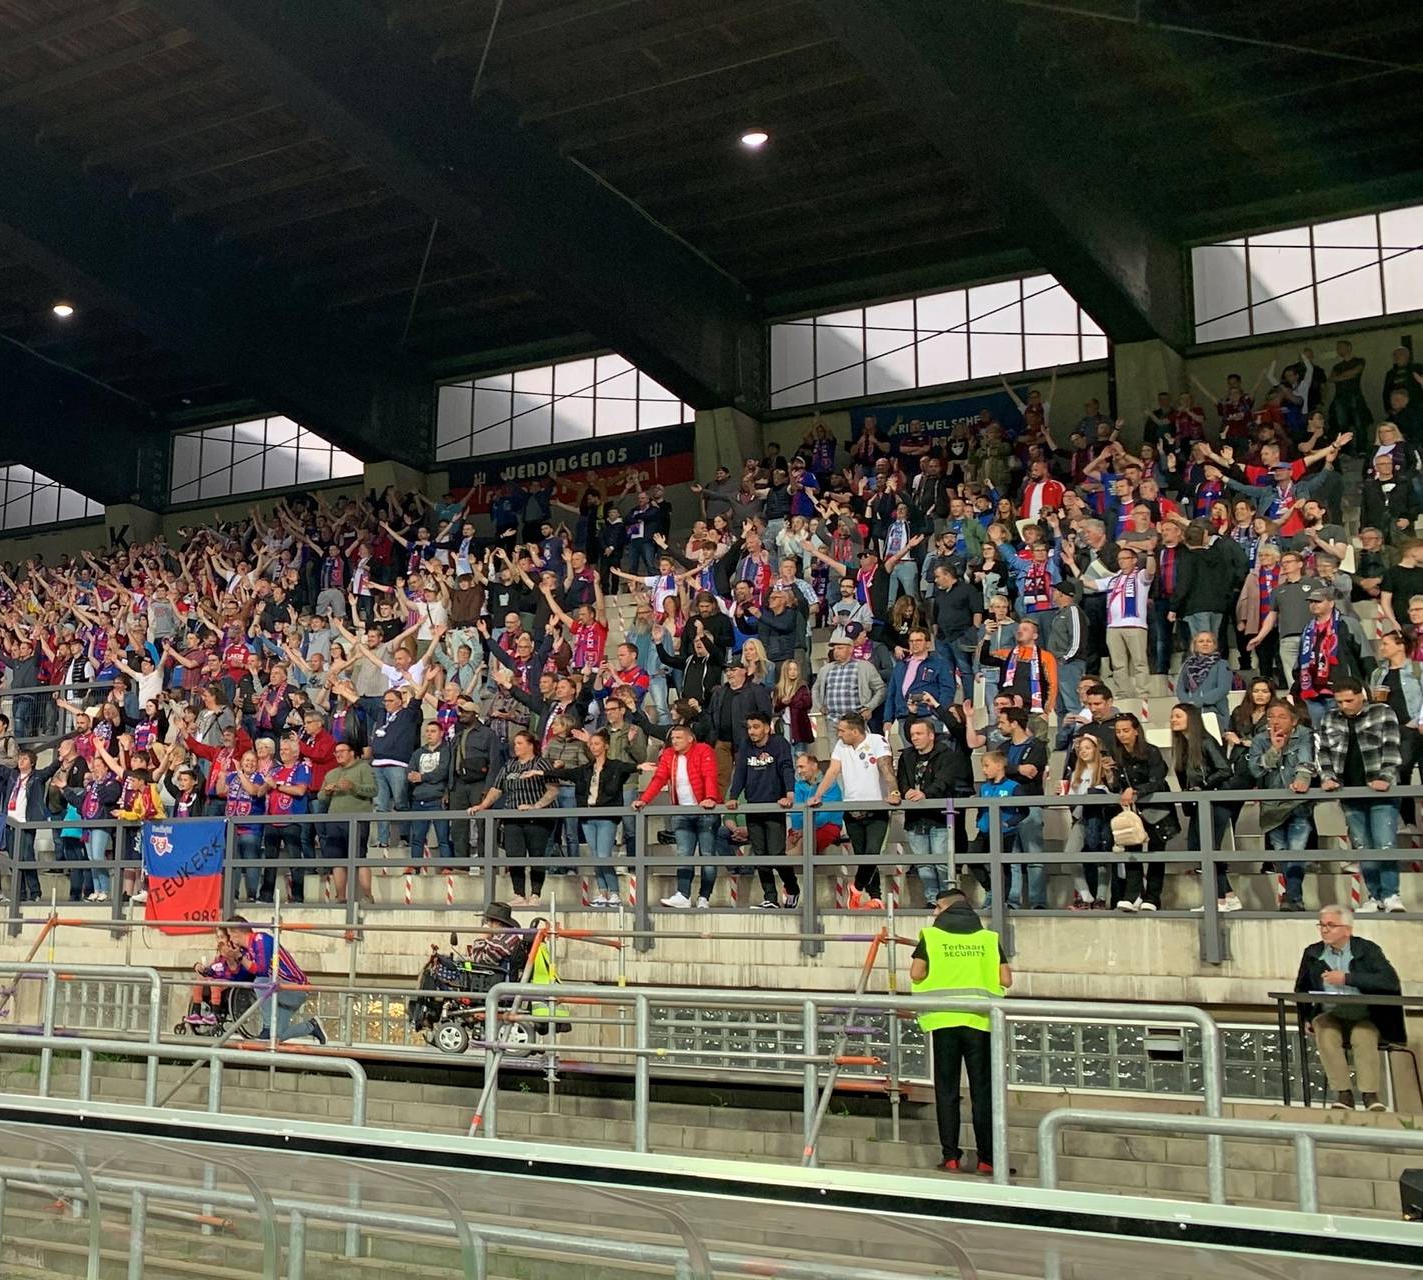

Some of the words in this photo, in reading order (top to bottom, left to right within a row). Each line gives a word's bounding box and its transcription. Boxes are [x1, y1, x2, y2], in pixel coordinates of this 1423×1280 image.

[505, 452, 601, 480] UERDINGEN
[607, 447, 627, 464] 05
[942, 943, 985, 951] Terhaart
[944, 950, 985, 958] SECURITY
